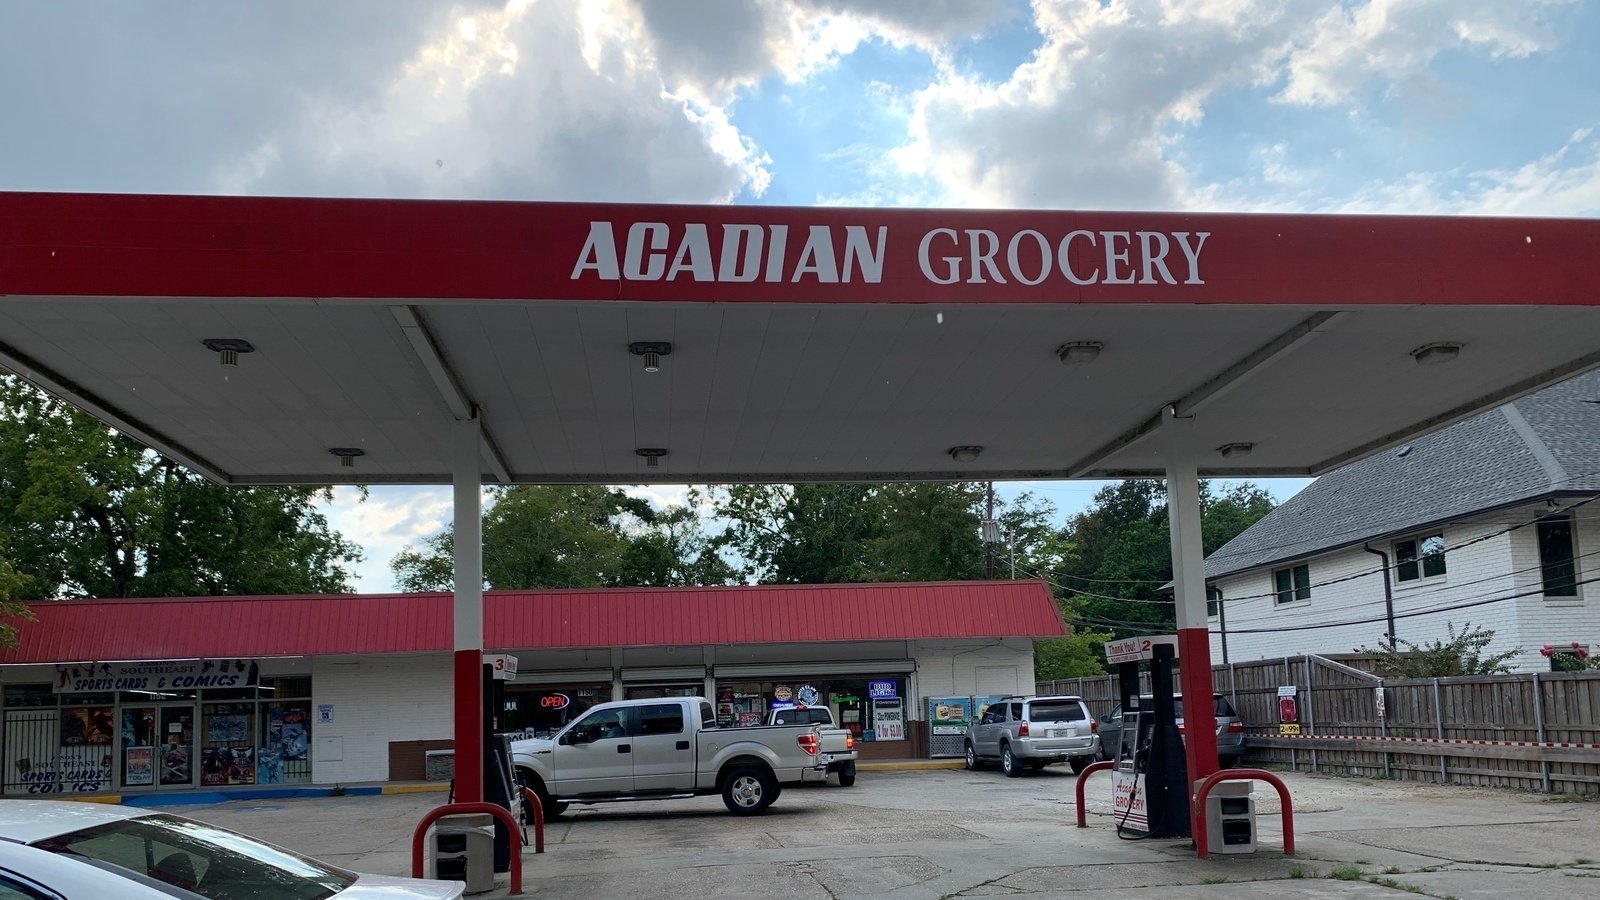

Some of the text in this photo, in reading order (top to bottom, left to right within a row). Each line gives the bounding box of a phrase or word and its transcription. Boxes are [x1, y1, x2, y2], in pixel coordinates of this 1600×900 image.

[570, 221, 1211, 285] ACADIAN GROCERY
[1109, 641, 1136, 655] Thank You!
[1142, 640, 1151, 651] 2
[121, 666, 196, 674] SOUTHEAST
[495, 659, 504, 670] 3
[75, 675, 239, 690] SPORTS CARDS & COMICS
[541, 696, 565, 707] OPEN
[878, 725, 881, 737] 2
[890, 725, 902, 737] $3.00
[68, 769, 103, 780] CARDS
[1116, 779, 1142, 795] Acadan
[1116, 796, 1145, 811] GROERY
